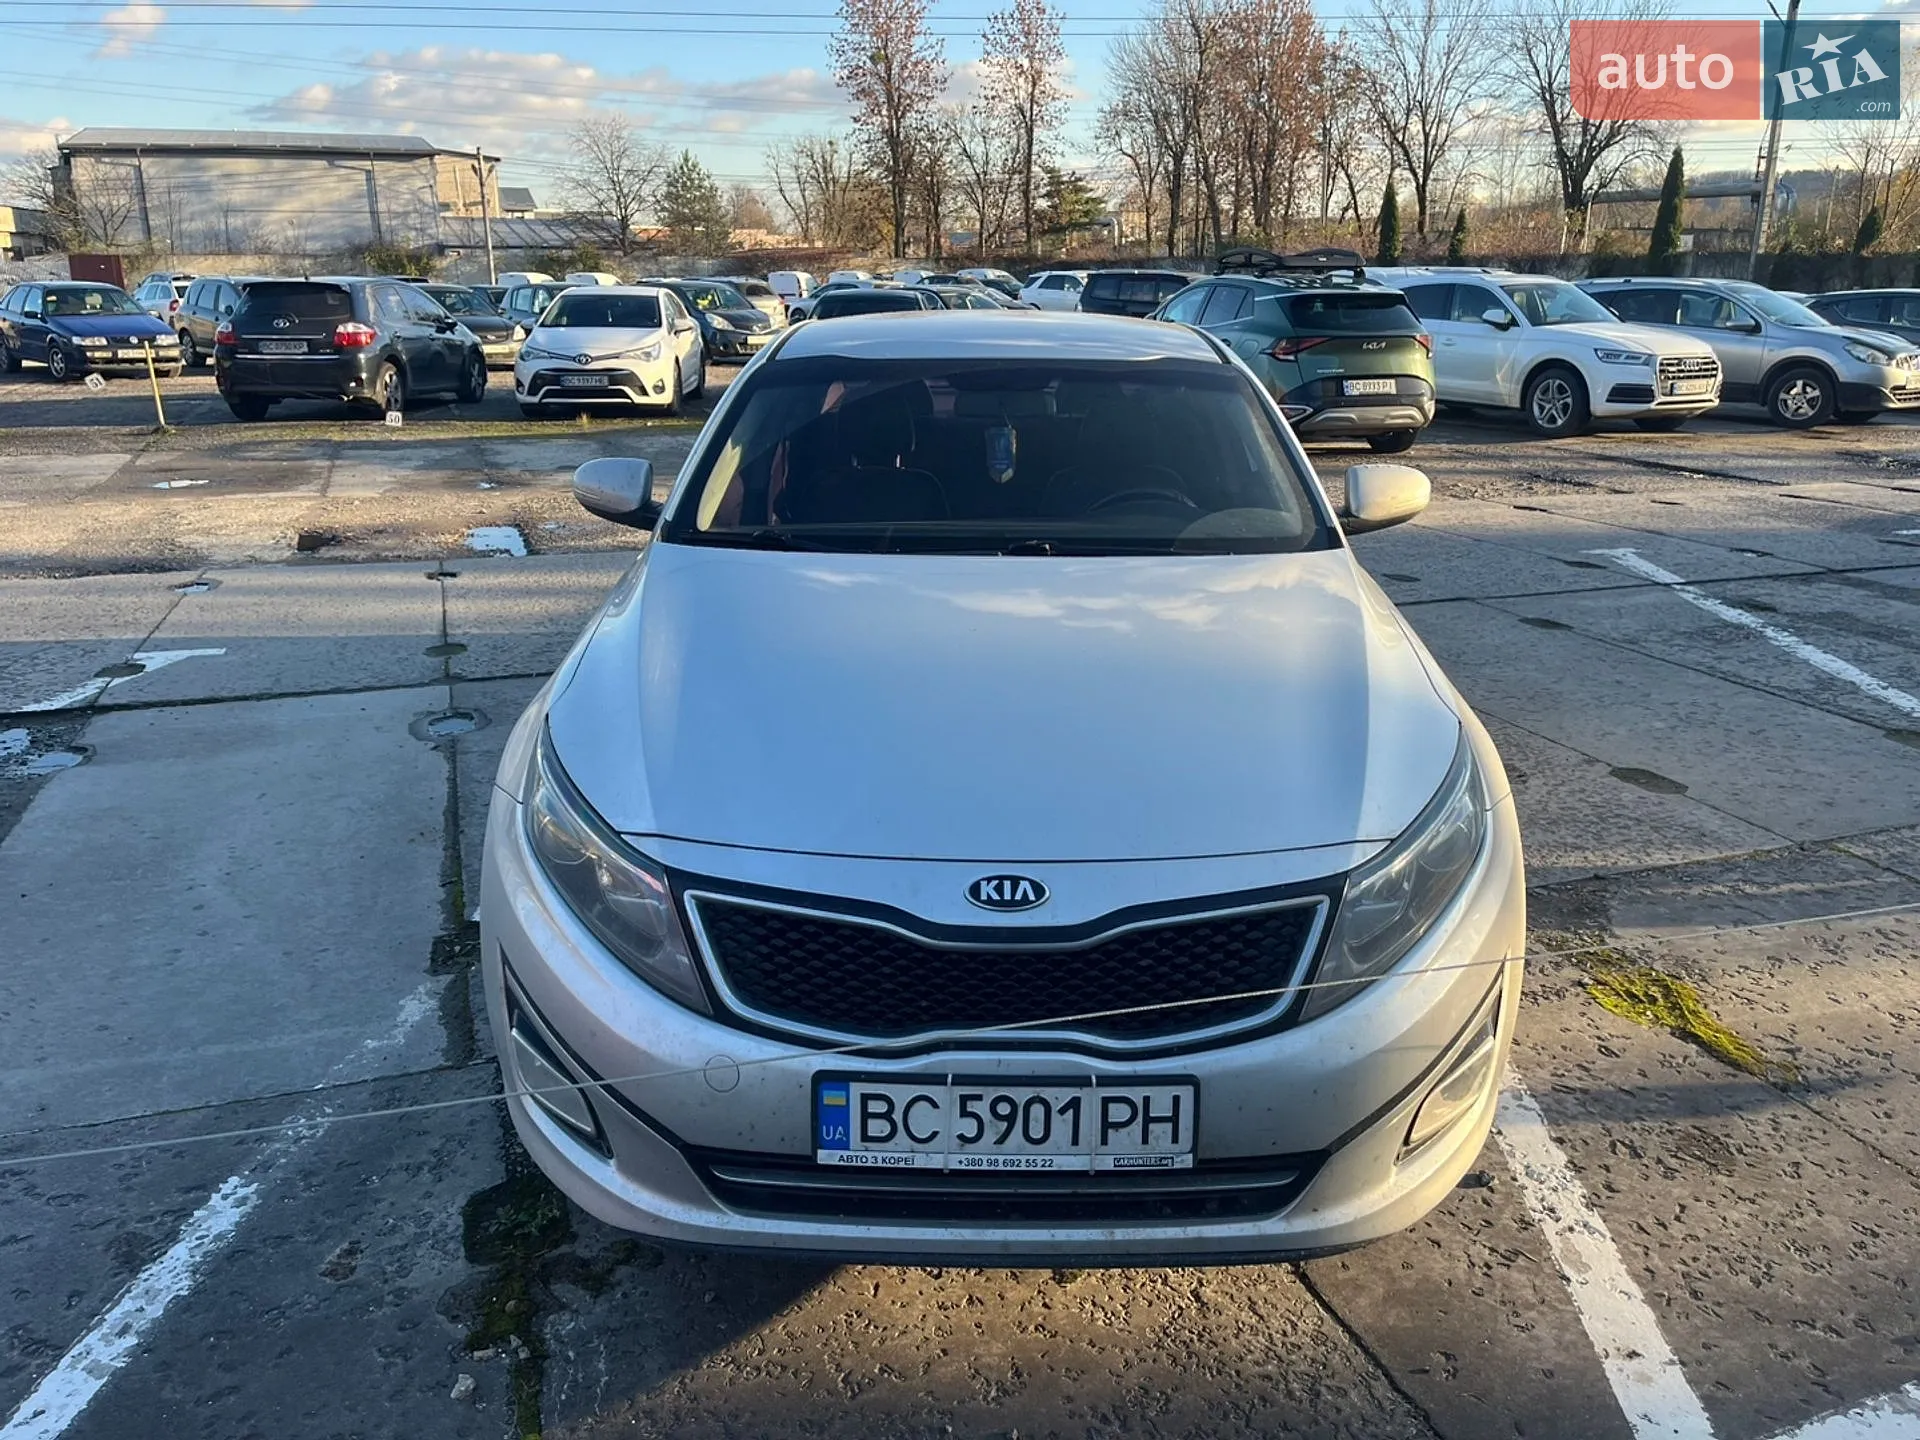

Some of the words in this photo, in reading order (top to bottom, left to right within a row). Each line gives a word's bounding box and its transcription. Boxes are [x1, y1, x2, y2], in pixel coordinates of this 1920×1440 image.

[1349, 381, 1361, 392] BC
[980, 879, 1036, 901] KIA
[822, 1125, 847, 1141] UA
[860, 1092, 941, 1144] BC
[956, 1093, 1082, 1146] 5901
[1100, 1094, 1181, 1146] PH
[838, 1154, 869, 1164] АВТО
[881, 1155, 916, 1166] КОРЕЇ
[958, 1157, 984, 1167] +380
[986, 1158, 1000, 1168] 98
[1002, 1158, 1022, 1168] 692
[1025, 1158, 1038, 1168] 55
[1040, 1158, 1054, 1168] 22
